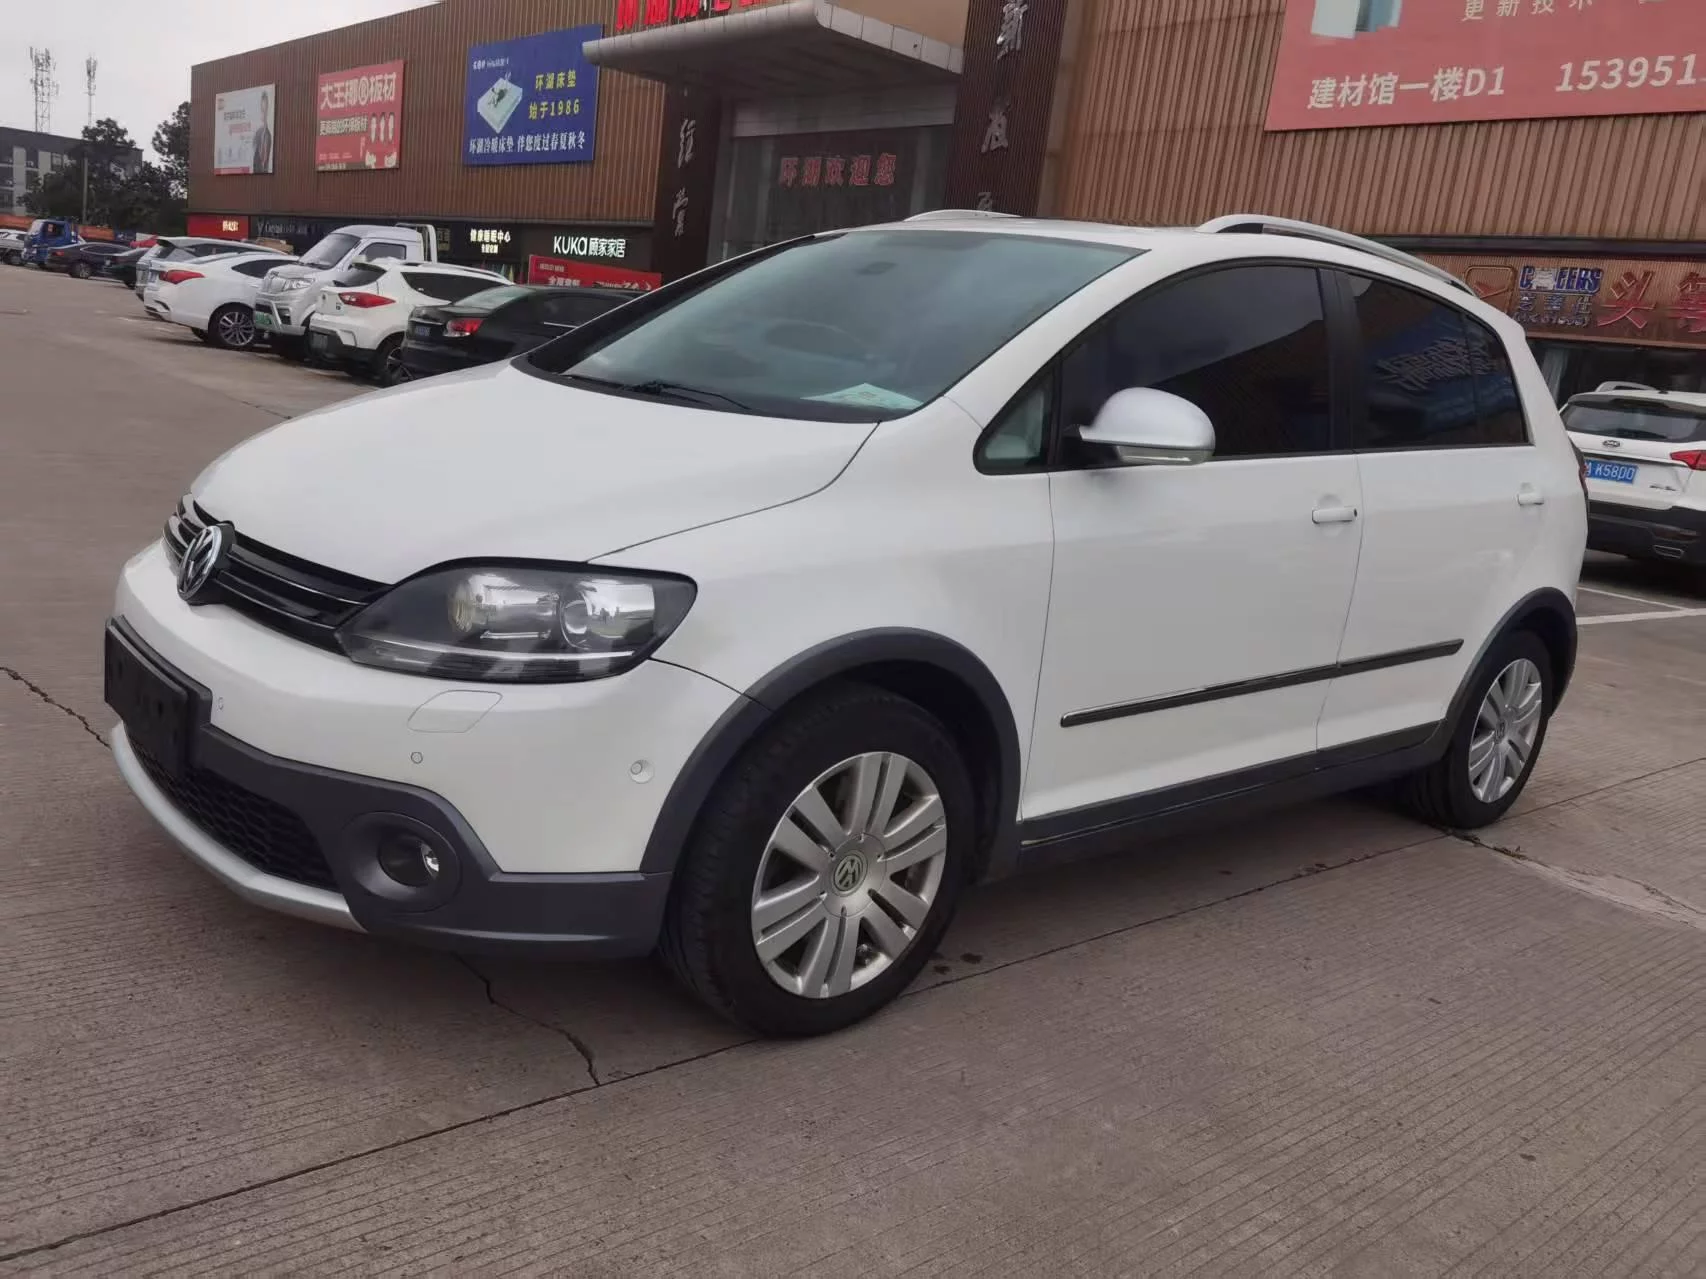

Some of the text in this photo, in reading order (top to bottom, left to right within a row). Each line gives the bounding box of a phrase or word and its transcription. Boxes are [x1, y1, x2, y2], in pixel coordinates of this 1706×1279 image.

[535, 69, 577, 91] 环湖床垫
[1307, 66, 1505, 109] 建材馆一楼D1
[1555, 53, 1706, 92] 153951
[528, 98, 580, 119] 始于1986
